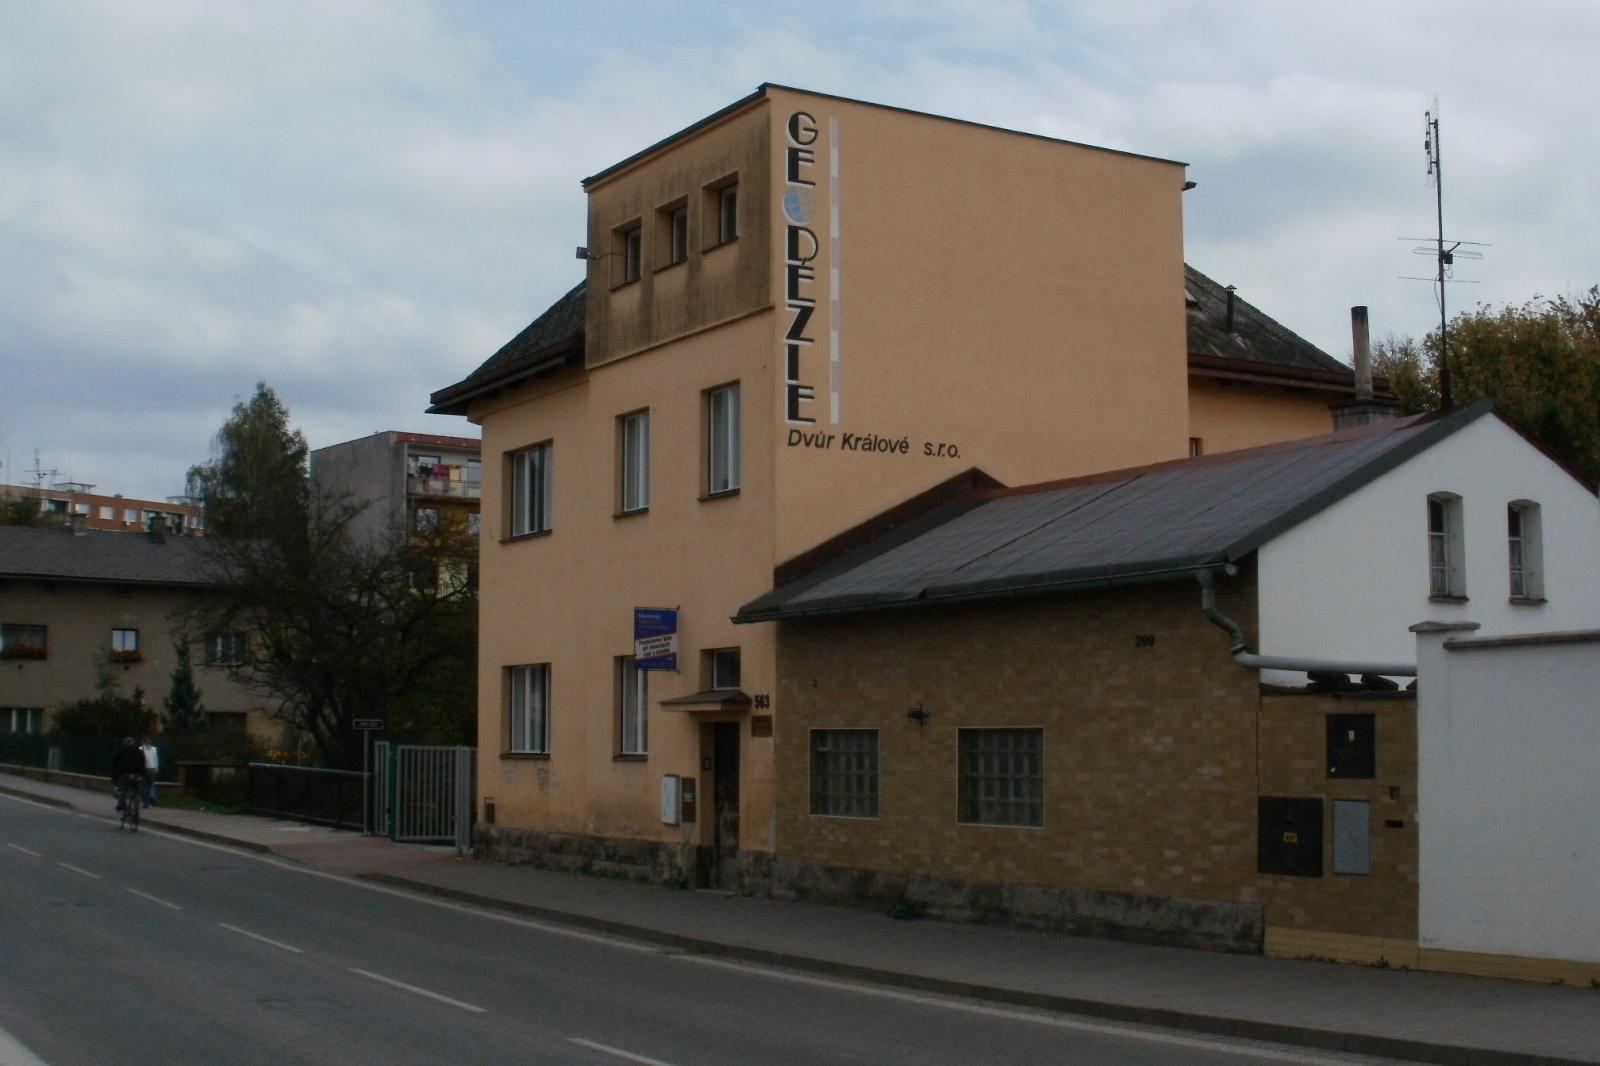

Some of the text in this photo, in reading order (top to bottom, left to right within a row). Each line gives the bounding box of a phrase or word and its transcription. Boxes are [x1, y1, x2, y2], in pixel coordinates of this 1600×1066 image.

[787, 429, 961, 459] Dvůr Králové s.r.o.
[755, 694, 769, 709] 563
